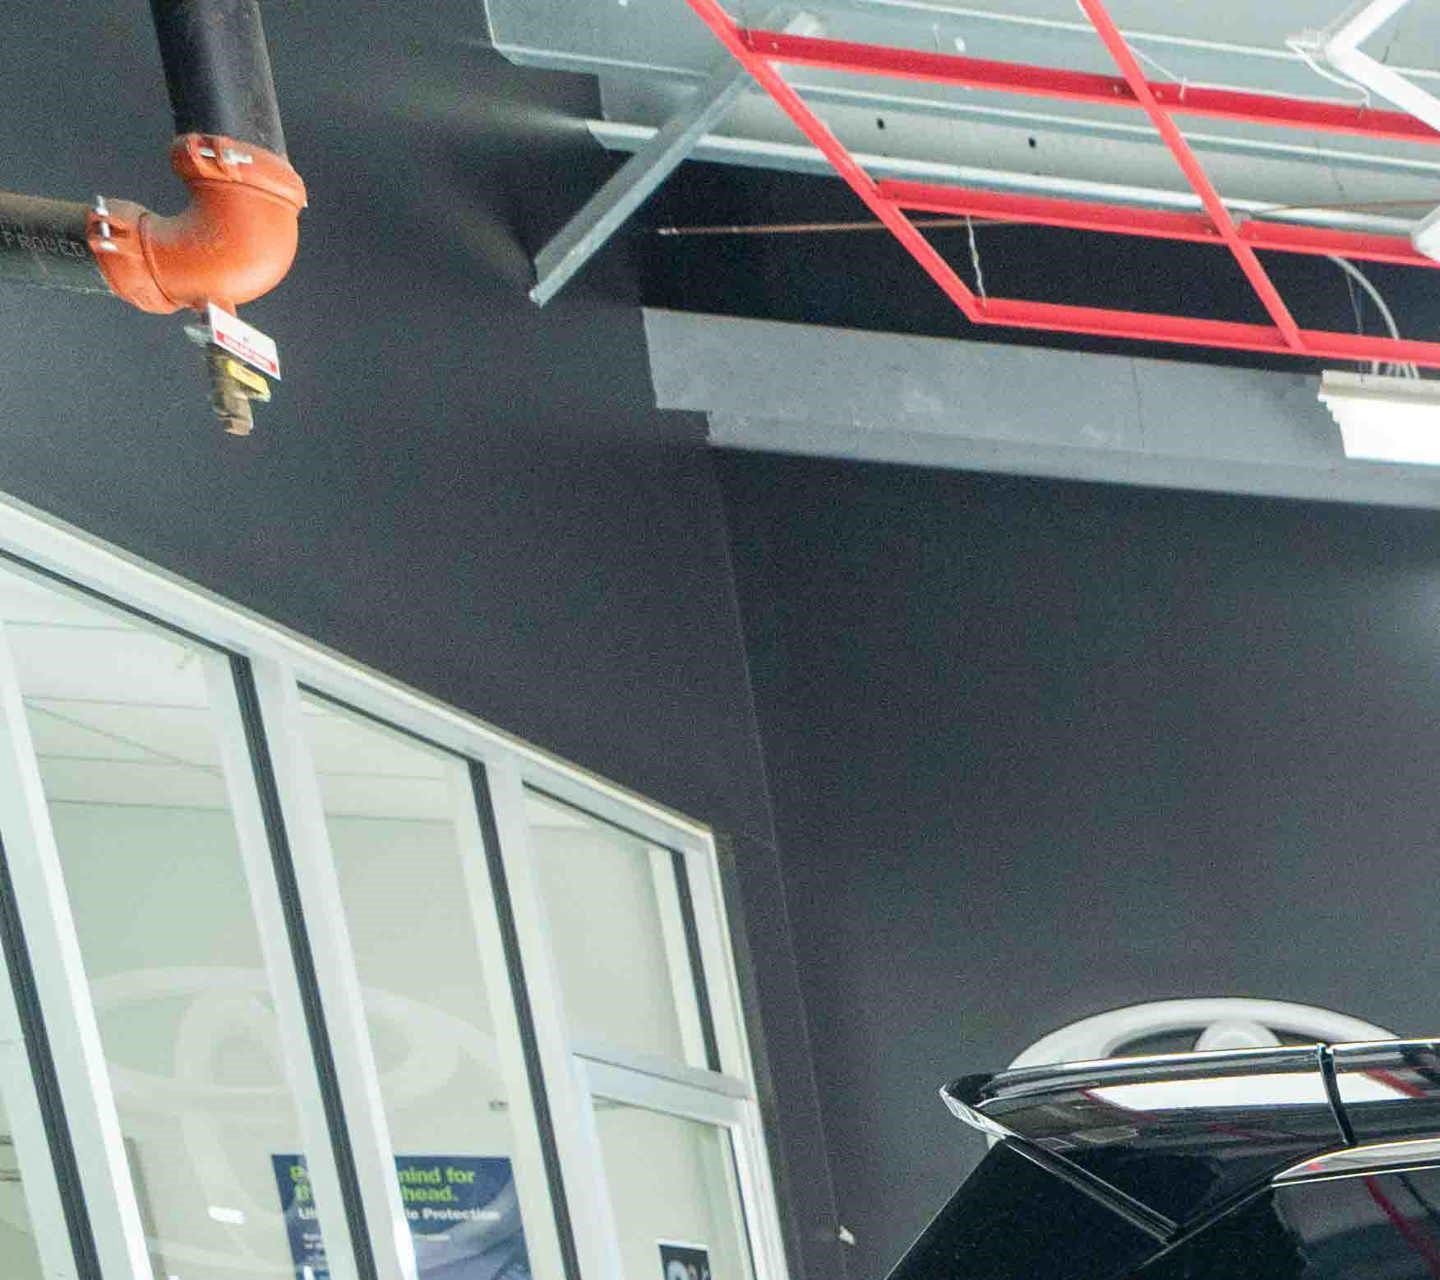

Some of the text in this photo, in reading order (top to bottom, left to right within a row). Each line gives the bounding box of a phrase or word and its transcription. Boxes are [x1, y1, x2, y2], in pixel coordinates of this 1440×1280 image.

[446, 1166, 475, 1184] for
[402, 1185, 459, 1202] head.
[422, 1208, 500, 1220] Protection
